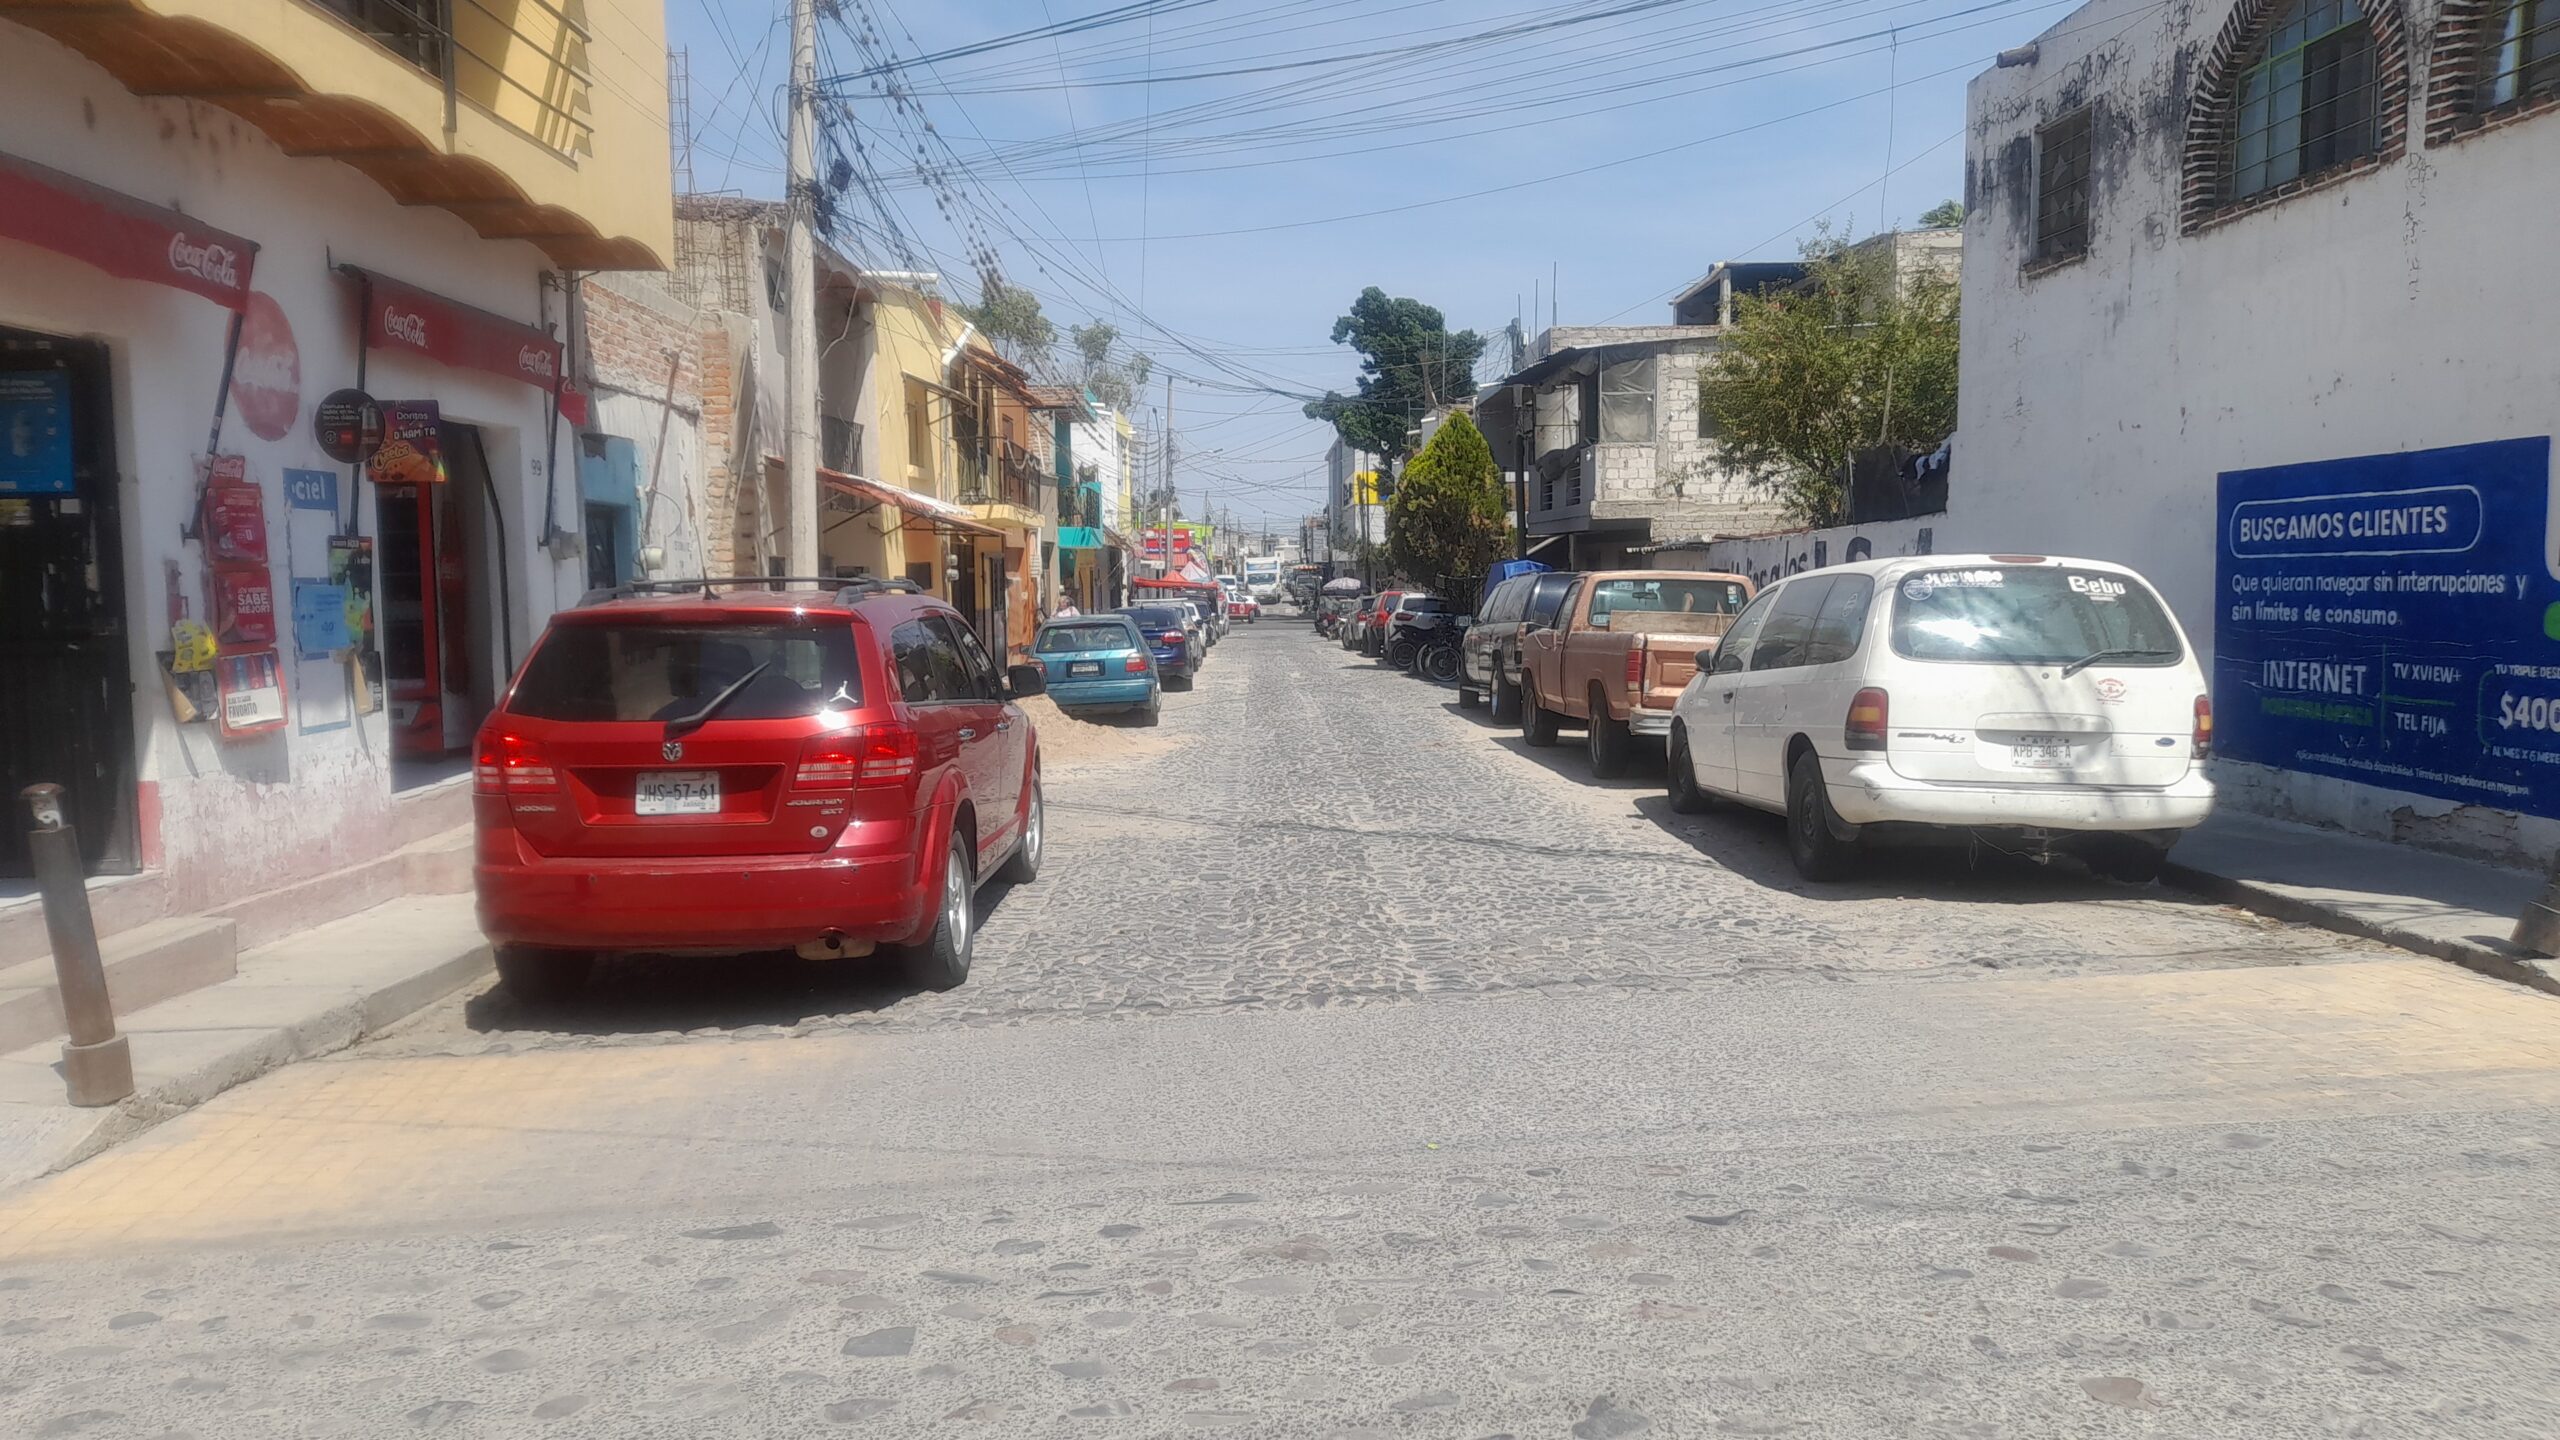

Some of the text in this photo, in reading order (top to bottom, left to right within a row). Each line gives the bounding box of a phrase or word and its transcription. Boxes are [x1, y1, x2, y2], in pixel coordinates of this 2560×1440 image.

[396, 411, 428, 420] Doritos
[295, 475, 326, 500] ciel
[2240, 505, 2448, 543] BUSCAMOS CLIENTES
[2231, 569, 2528, 600] Que quieran navegar sin interrupciones y
[237, 593, 269, 605] SABE
[2231, 601, 2251, 622] sin
[2255, 599, 2299, 622] límites
[2304, 603, 2321, 622] de
[2262, 659, 2367, 695] INTERNET
[2392, 662, 2462, 684] TV XVIEW+
[2509, 664, 2538, 678] TRIPLE
[228, 702, 258, 719] FAVORITO
[2394, 711, 2418, 732] TEL
[2421, 715, 2447, 738] FIJA
[639, 783, 716, 802] JHS-57-61
